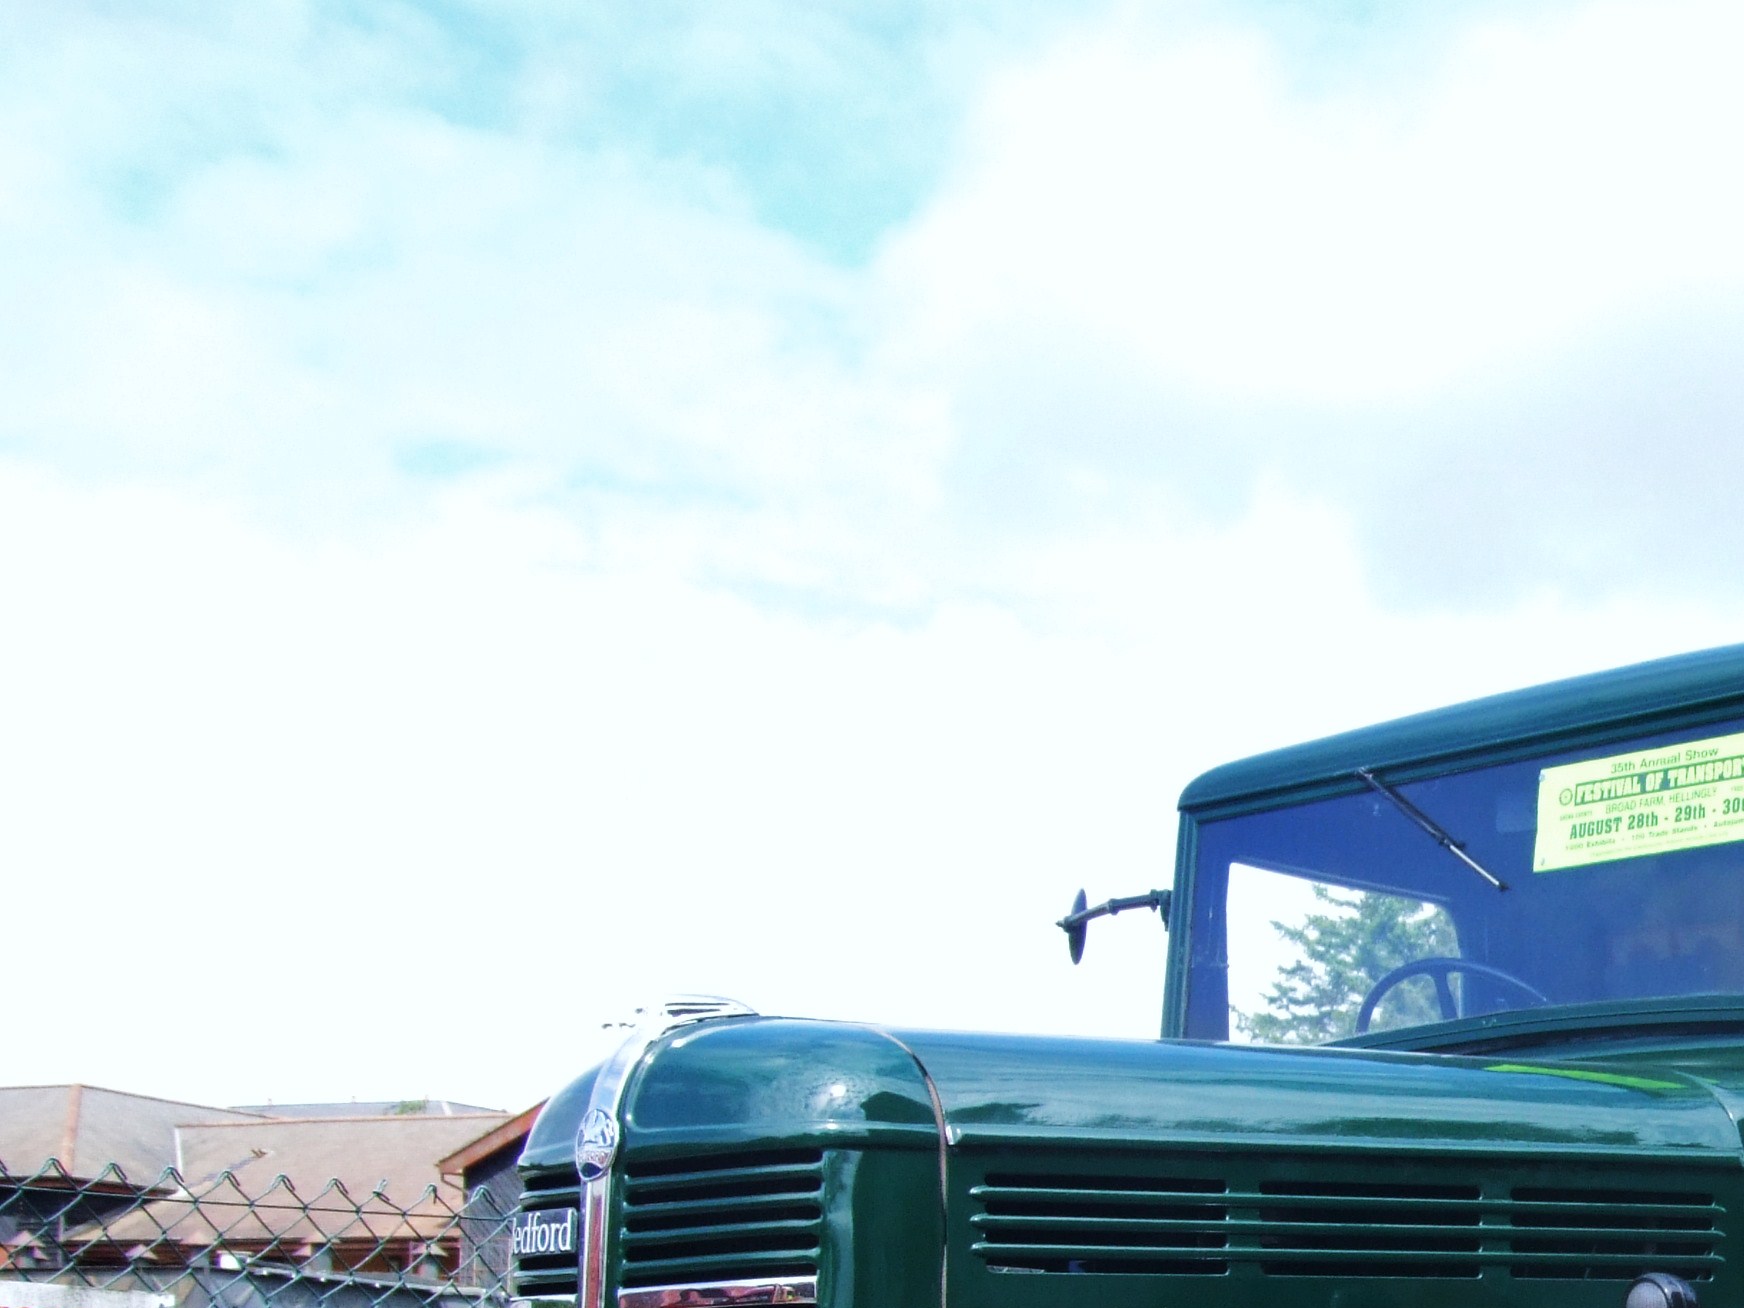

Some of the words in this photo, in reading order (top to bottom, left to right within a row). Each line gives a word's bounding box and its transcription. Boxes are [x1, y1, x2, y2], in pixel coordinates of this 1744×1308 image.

[1611, 762, 1635, 774] 35th
[1640, 752, 1681, 769] Annual
[1685, 748, 1719, 762] Show
[1576, 775, 1641, 804] FESTIVAL
[1645, 771, 1664, 792] OF
[1605, 801, 1637, 815] BROAD
[1669, 786, 1718, 803] HELLINGLY
[1569, 816, 1623, 840] AUGUST
[1627, 811, 1659, 830] 28th
[1674, 803, 1706, 823] 29th
